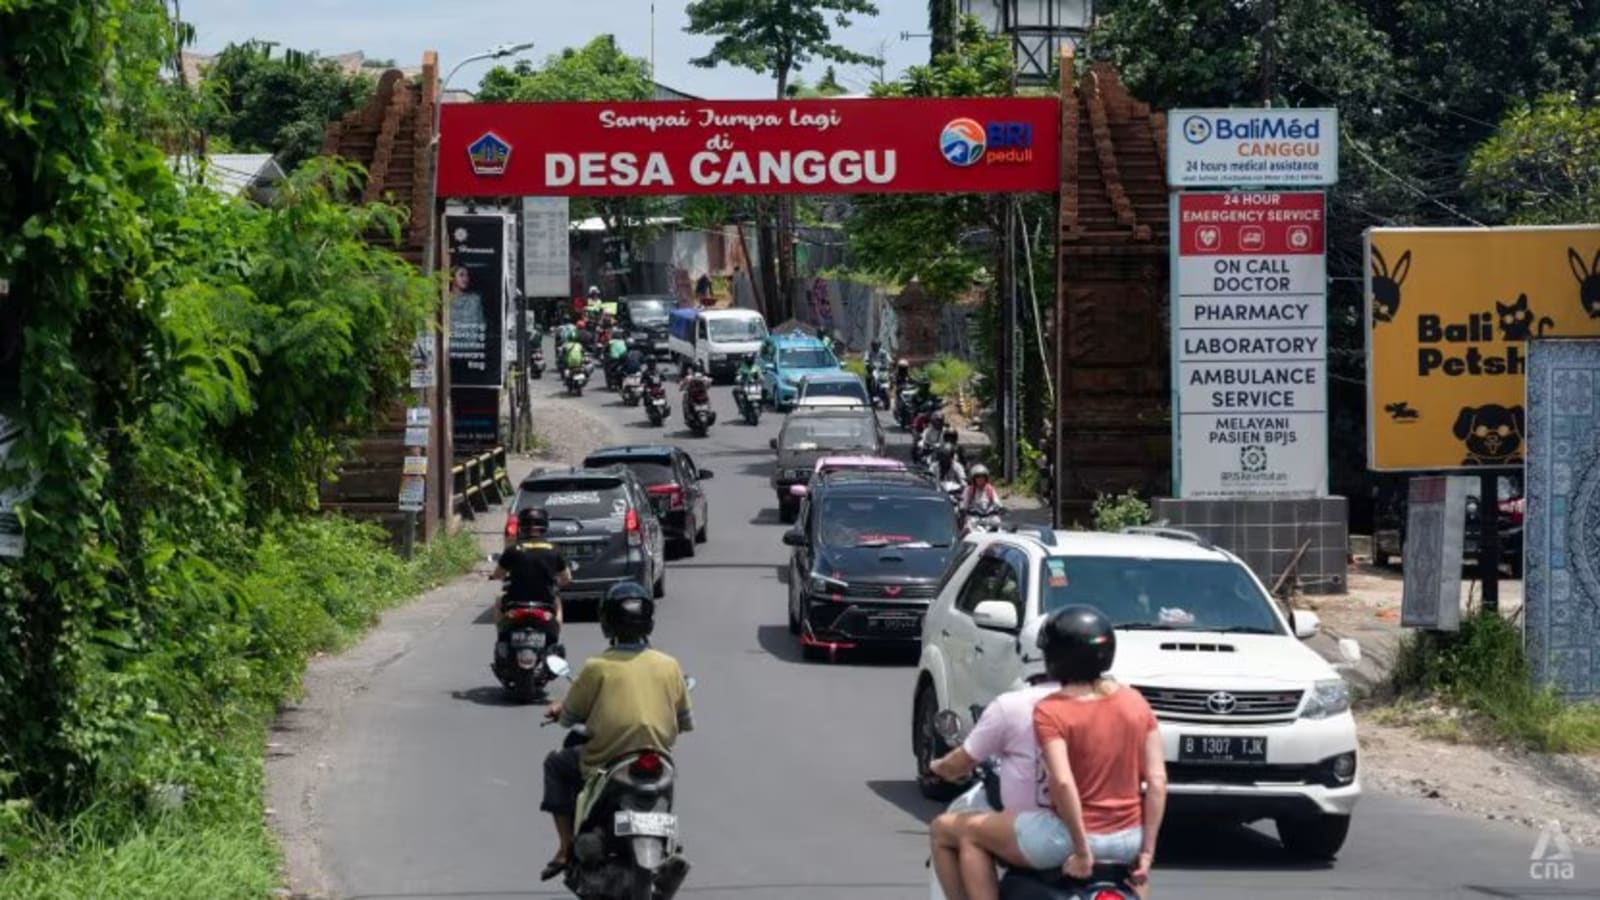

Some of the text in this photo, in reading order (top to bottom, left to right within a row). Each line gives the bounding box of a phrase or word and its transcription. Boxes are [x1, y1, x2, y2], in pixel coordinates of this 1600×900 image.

[599, 108, 841, 132] Sampai Jumpa Lagi
[1216, 117, 1319, 140] BaliMéd
[706, 133, 734, 151] di
[986, 121, 1033, 147] BRI
[986, 149, 1033, 165] peduli
[1237, 142, 1319, 157] CANGGU
[545, 149, 897, 187] DESA CANGGU
[1186, 159, 1319, 172] 24 hours medical assistance
[1223, 194, 1280, 206] 24 HOUR
[1183, 209, 1321, 222] EMERGENCY SERVICE
[1214, 258, 1290, 274] ON CALL
[1214, 277, 1290, 292] DOCTOR
[1195, 304, 1309, 321] PHARMACY
[1418, 313, 1492, 343] Bali
[1185, 337, 1318, 354] LABORATORY
[1418, 347, 1525, 376] Petsh
[1190, 368, 1316, 385] AMBULANCE
[1212, 391, 1294, 407] SERVICE
[1216, 418, 1289, 430] MELAYANI
[1209, 431, 1297, 446] PASIEN BPJS
[1186, 737, 1264, 754] B 1307 TJK
